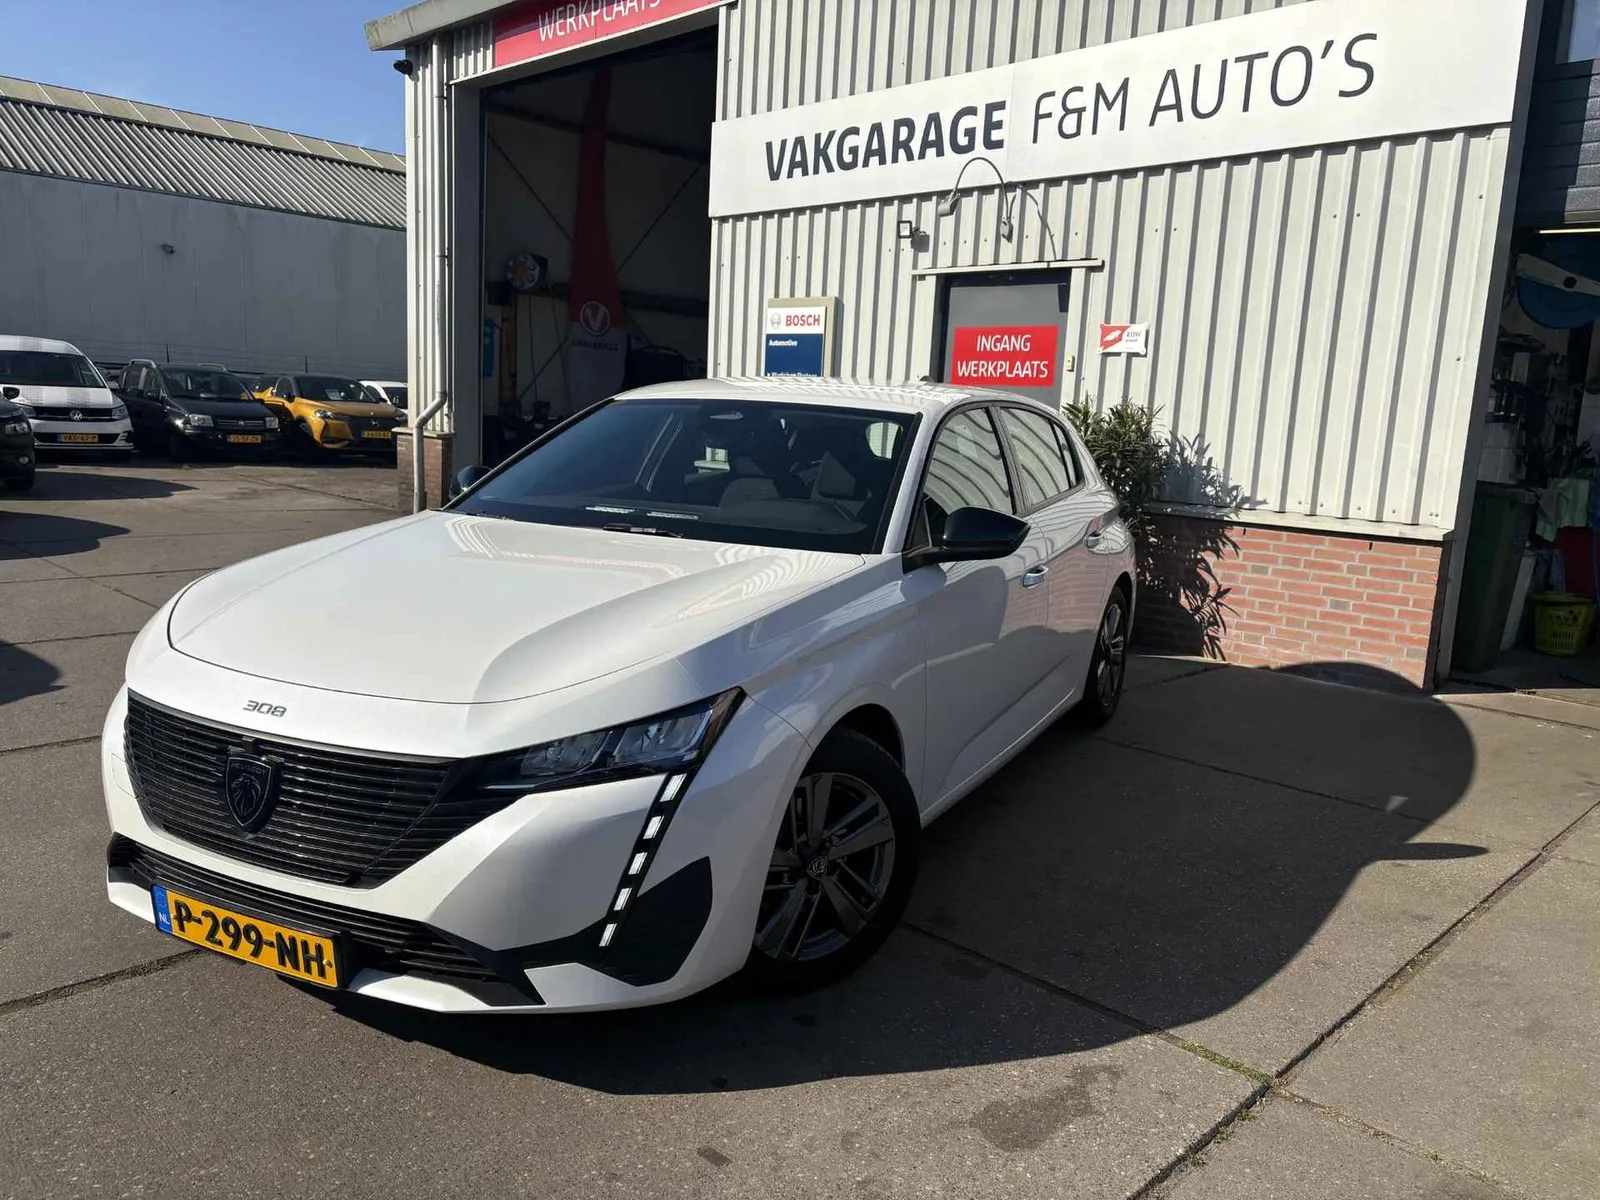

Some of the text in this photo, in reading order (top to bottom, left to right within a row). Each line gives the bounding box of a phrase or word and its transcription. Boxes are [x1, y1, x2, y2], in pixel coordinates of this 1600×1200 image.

[538, 0, 660, 42] WERKPLAA
[764, 33, 1378, 182] VAKGARAGE F&M AUTO'S
[785, 314, 821, 327] BOSCH
[768, 339, 798, 347] Automotive
[976, 334, 1031, 352] INGANG
[957, 360, 1048, 378] WERKPLAATS
[243, 700, 287, 718] 308
[159, 912, 170, 925] NL
[174, 899, 327, 979] P-299-NH
